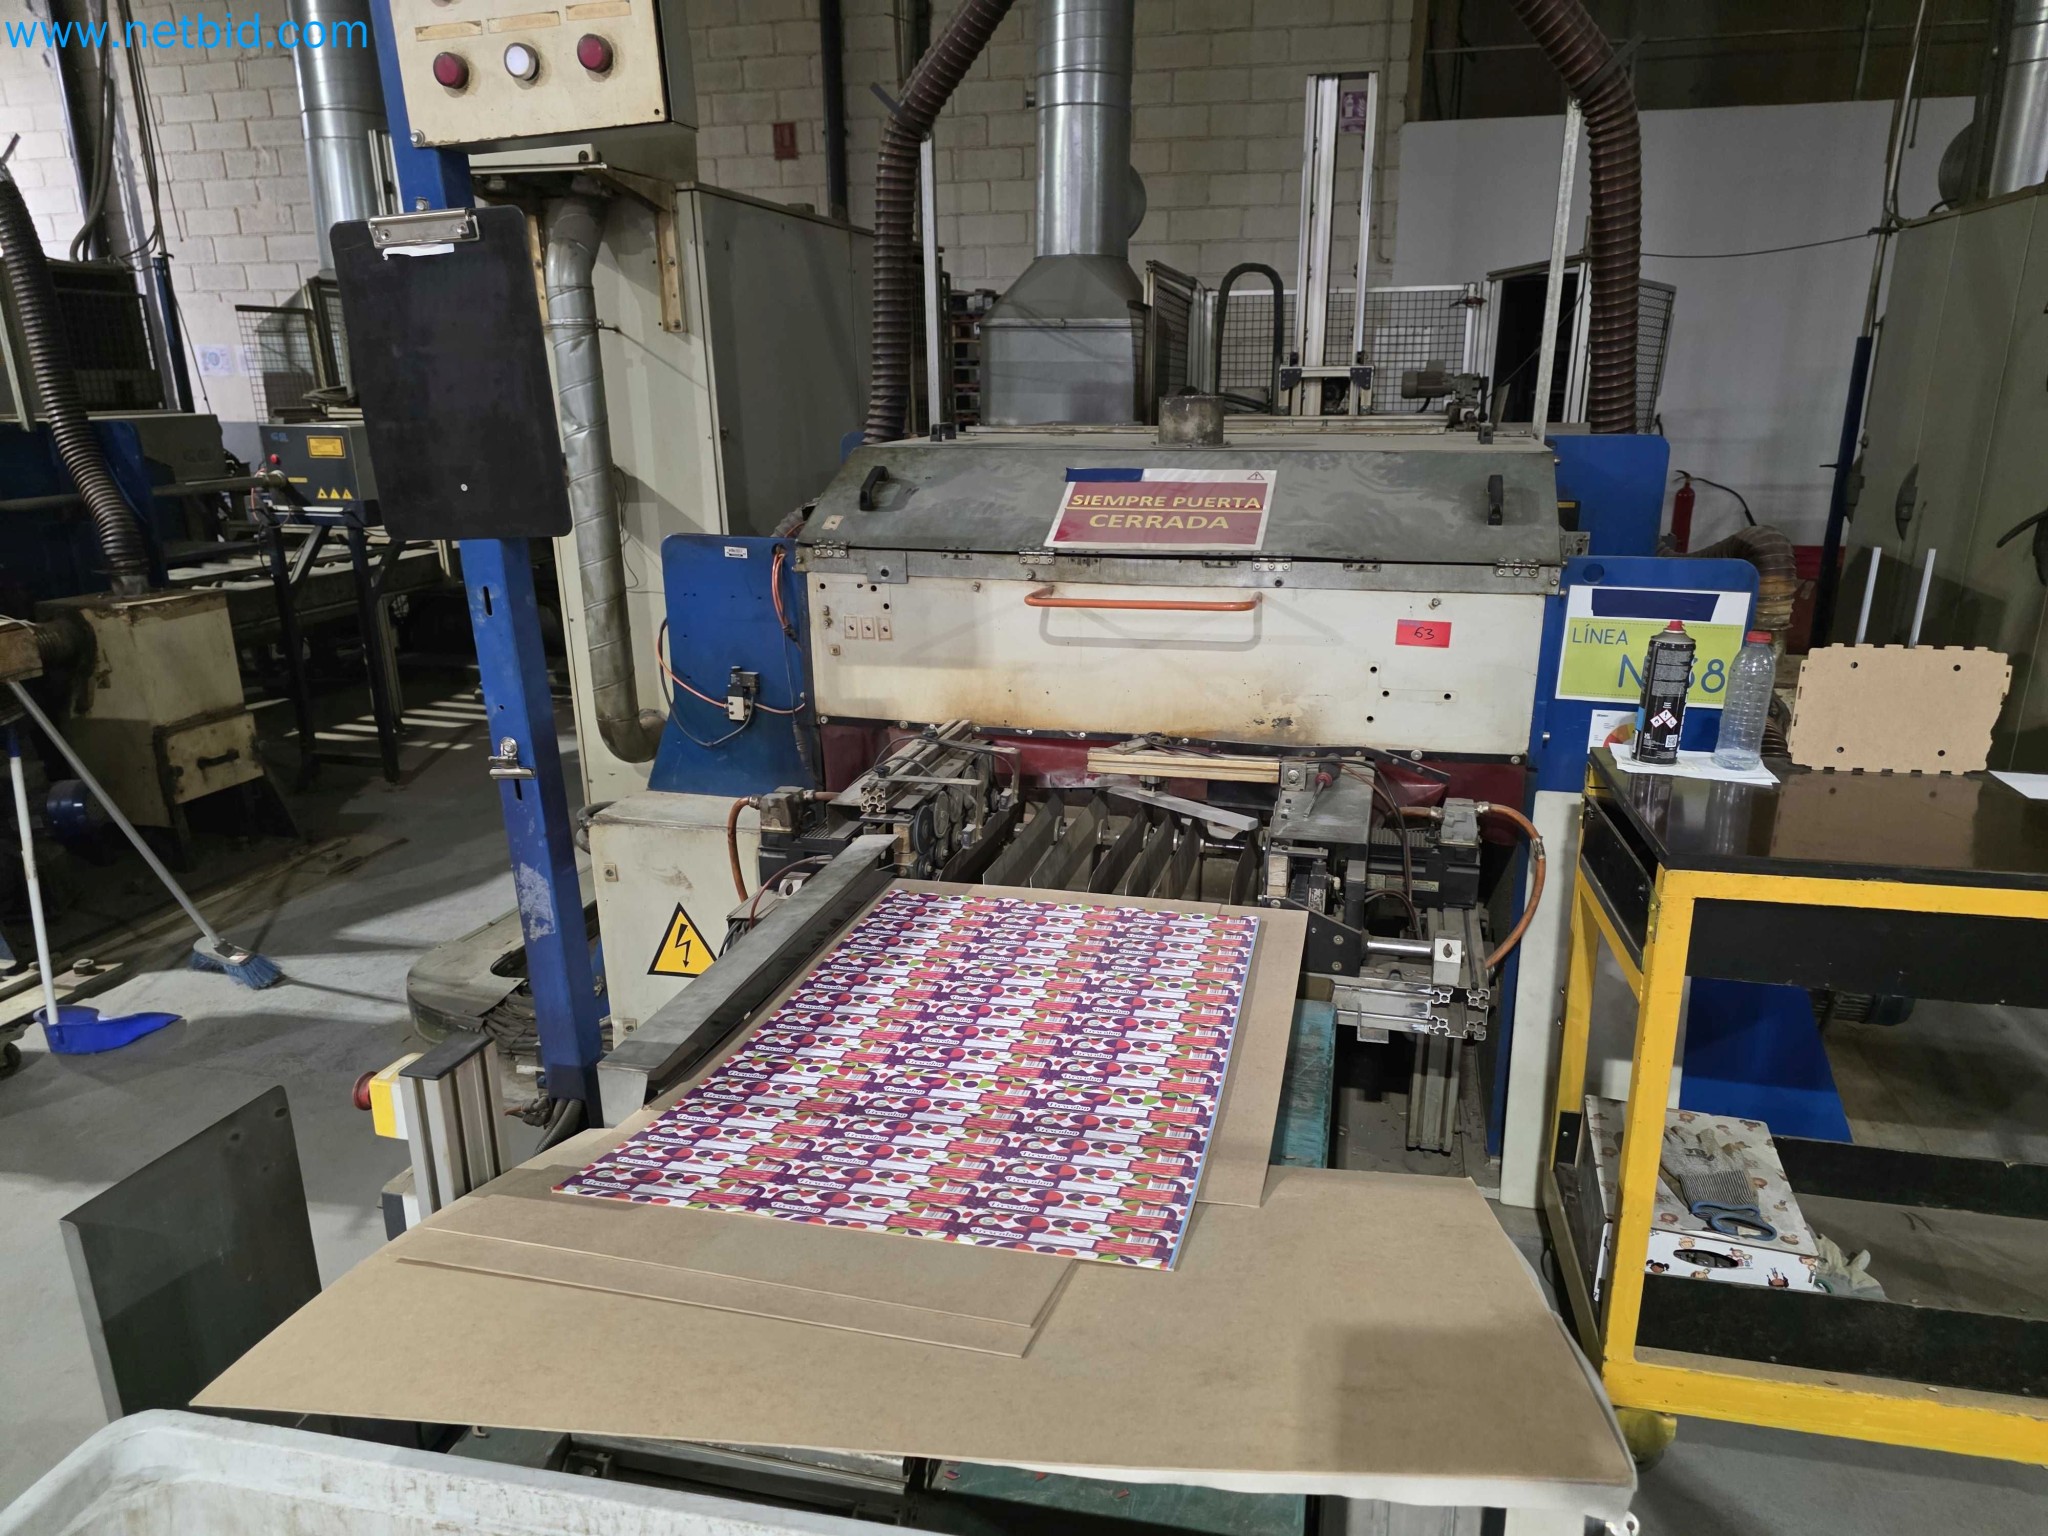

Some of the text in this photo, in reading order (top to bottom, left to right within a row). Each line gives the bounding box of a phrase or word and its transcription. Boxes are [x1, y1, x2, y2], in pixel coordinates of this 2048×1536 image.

[1071, 494, 1261, 509] SIEMPRE PUERTA
[1089, 514, 1230, 530] CERRADA
[1414, 626, 1435, 640] 63
[1572, 624, 1628, 646] LÍNEA
